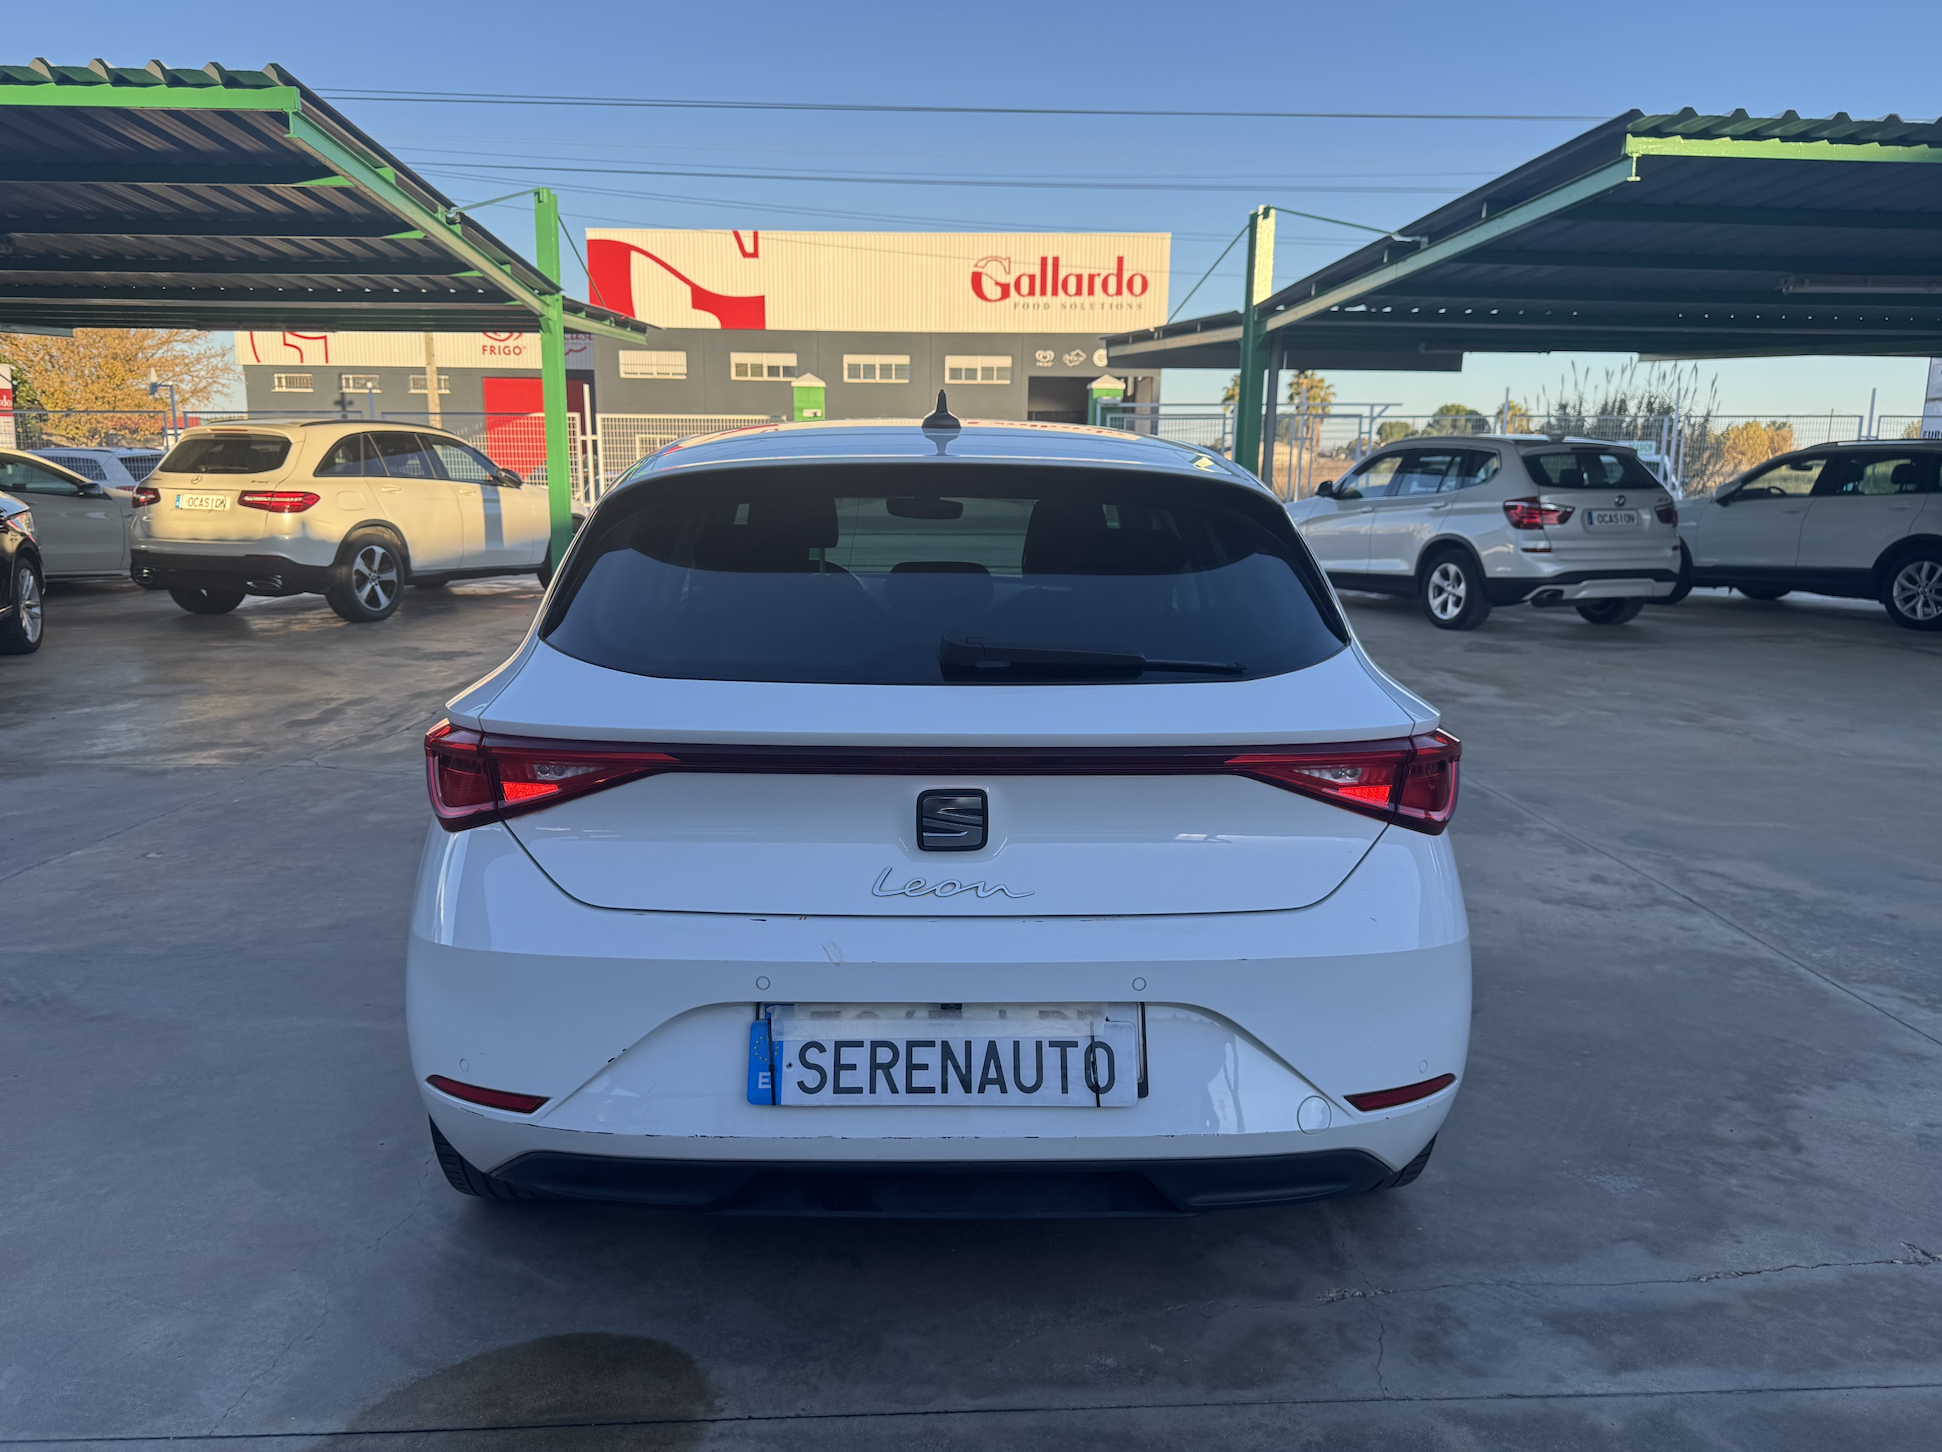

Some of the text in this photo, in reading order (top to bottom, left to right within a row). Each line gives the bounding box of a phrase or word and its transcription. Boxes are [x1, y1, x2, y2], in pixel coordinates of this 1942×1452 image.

[971, 255, 1149, 303] Gallardo
[1013, 302, 1143, 311] FOOD SOLUTIONS
[482, 345, 523, 356] FRIGO
[186, 496, 227, 509] OCASION
[1596, 512, 1636, 525] OCASION
[872, 866, 1035, 899] Leon
[797, 1040, 1115, 1095] SERENAUTO
[758, 1072, 772, 1089] E
